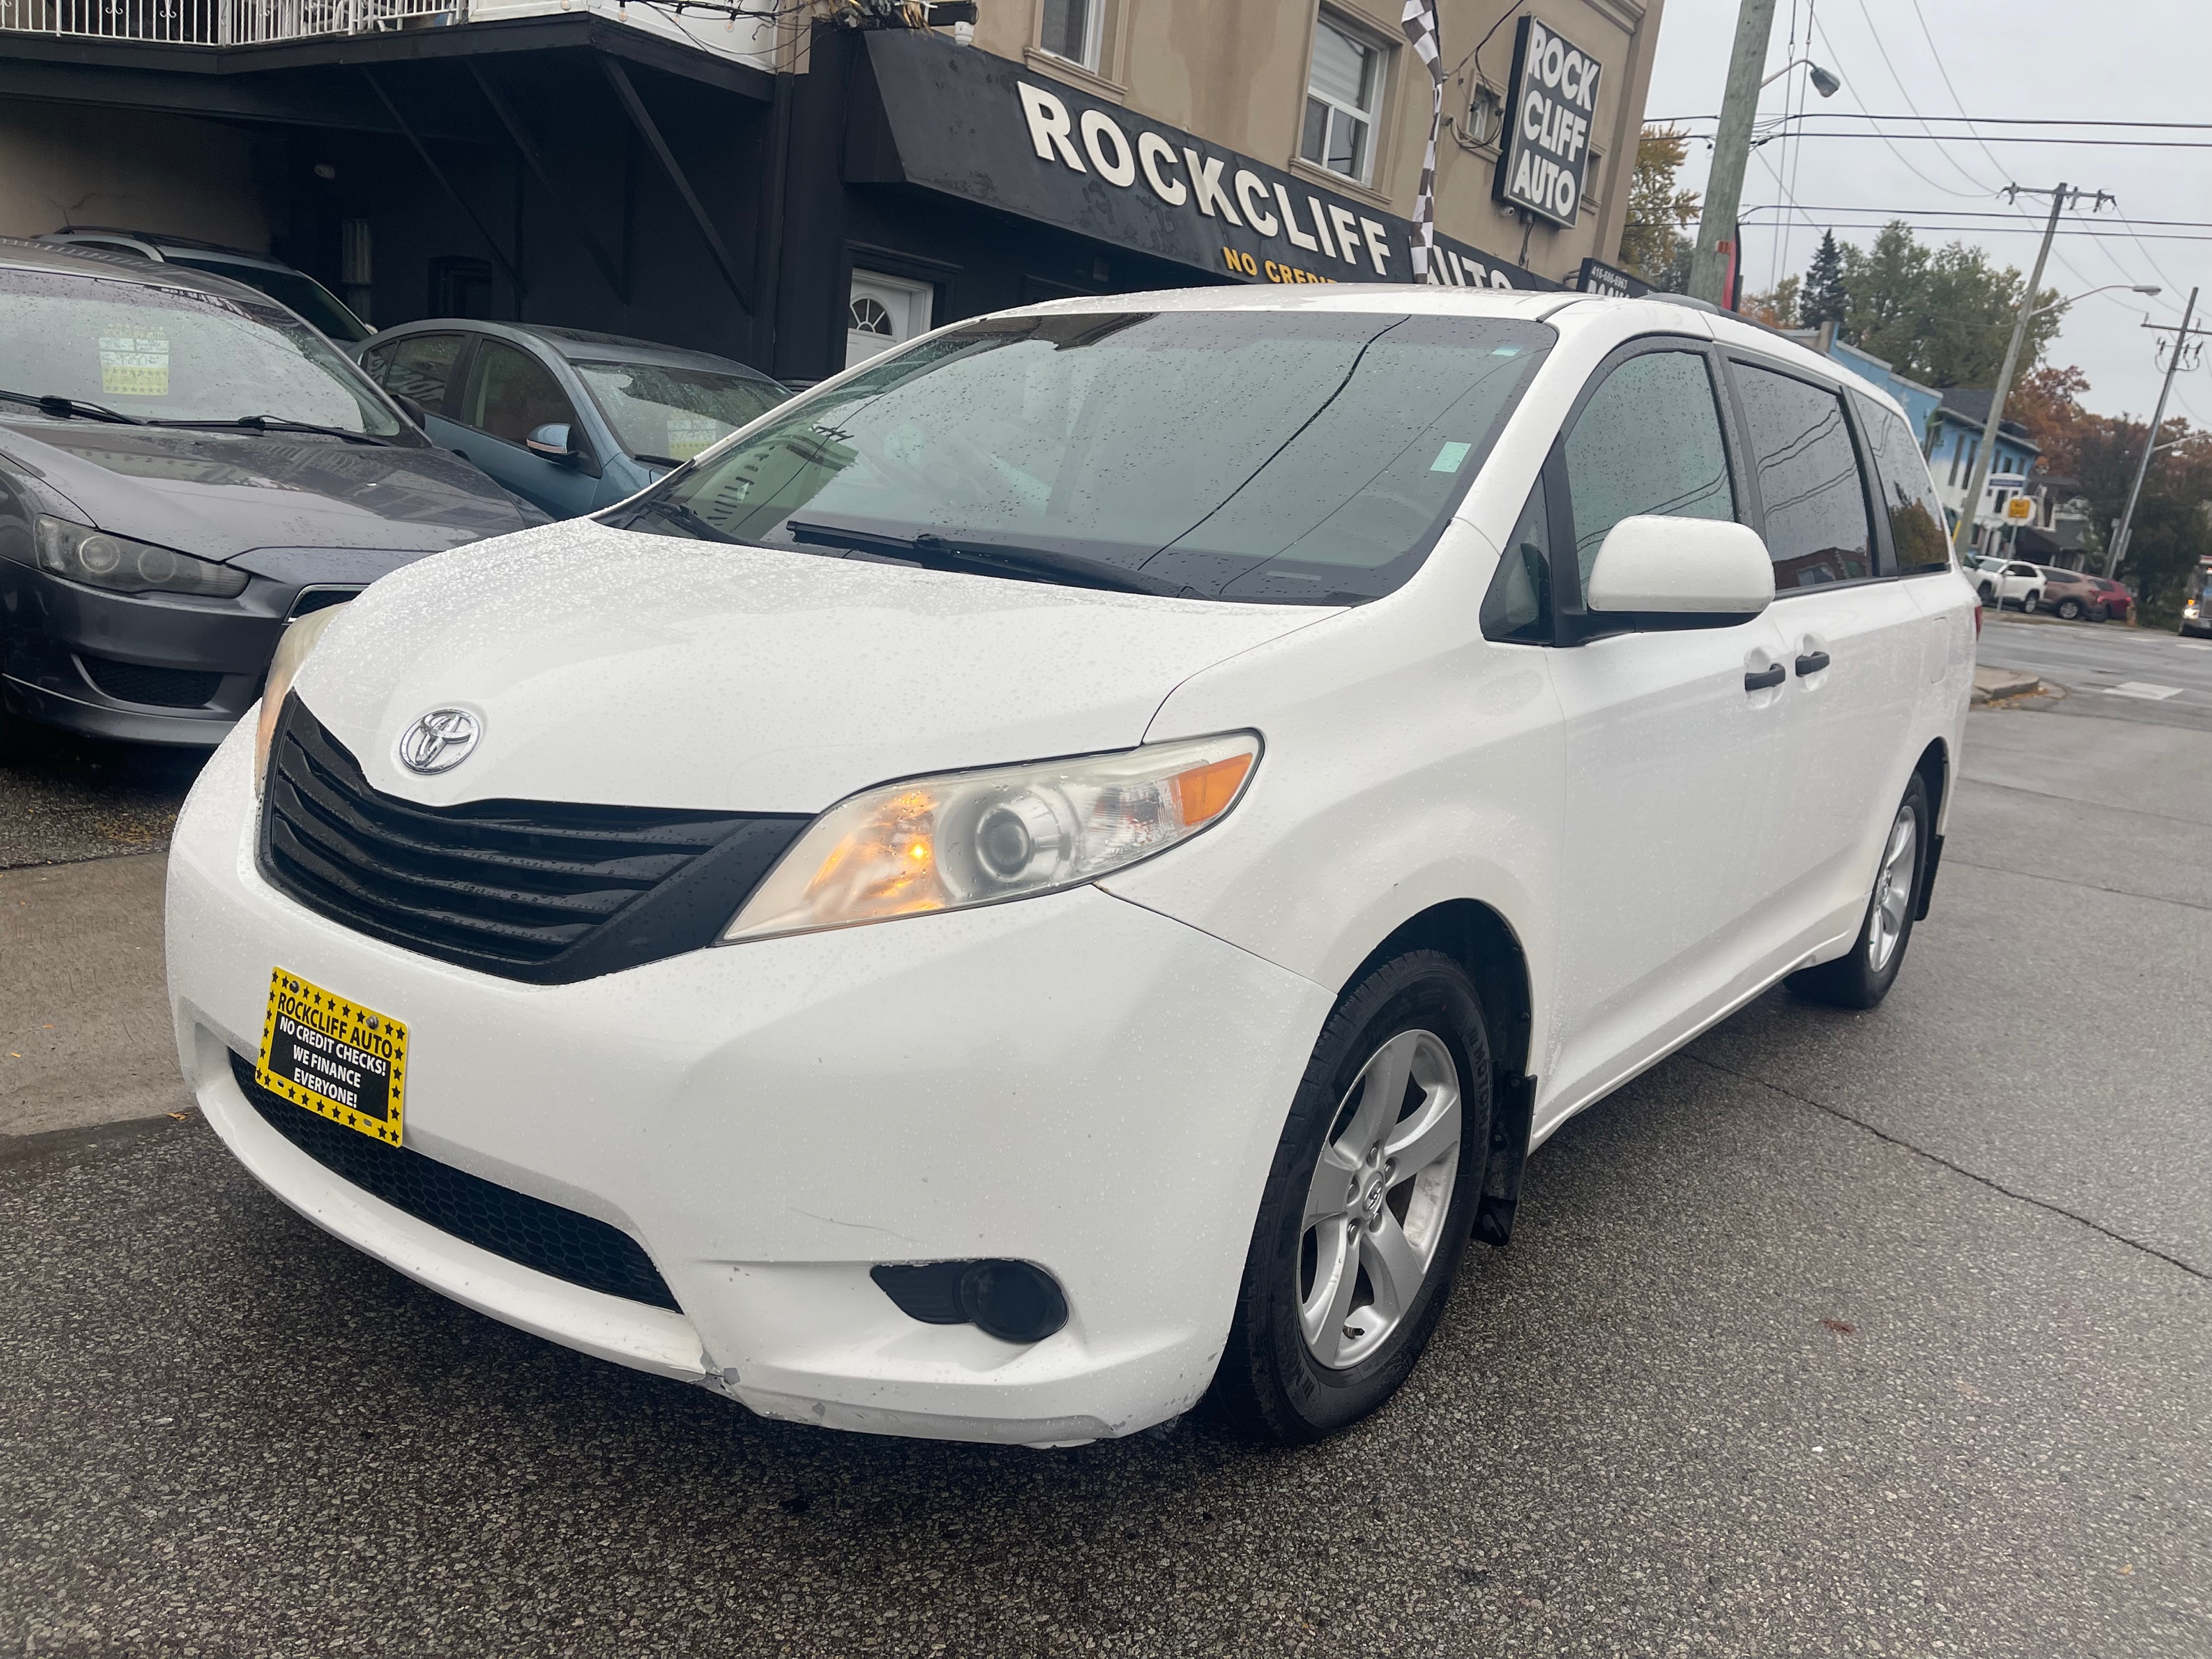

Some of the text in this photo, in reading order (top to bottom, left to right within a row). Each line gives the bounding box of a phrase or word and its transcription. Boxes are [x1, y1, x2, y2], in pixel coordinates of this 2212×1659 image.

[1528, 22, 1599, 112] ROCK
[1524, 90, 1587, 162] CLIFF
[1017, 81, 1391, 276] ROCKCLIFF
[1513, 148, 1575, 216] AUTO
[1223, 246, 1337, 284] NO CRED
[278, 992, 392, 1059] ROCKCLIFF AUTO
[279, 1015, 386, 1076] NO CREDIT CHECKS!
[293, 1044, 361, 1088] WE FINANCE
[293, 1067, 358, 1109] EVERYONE!
